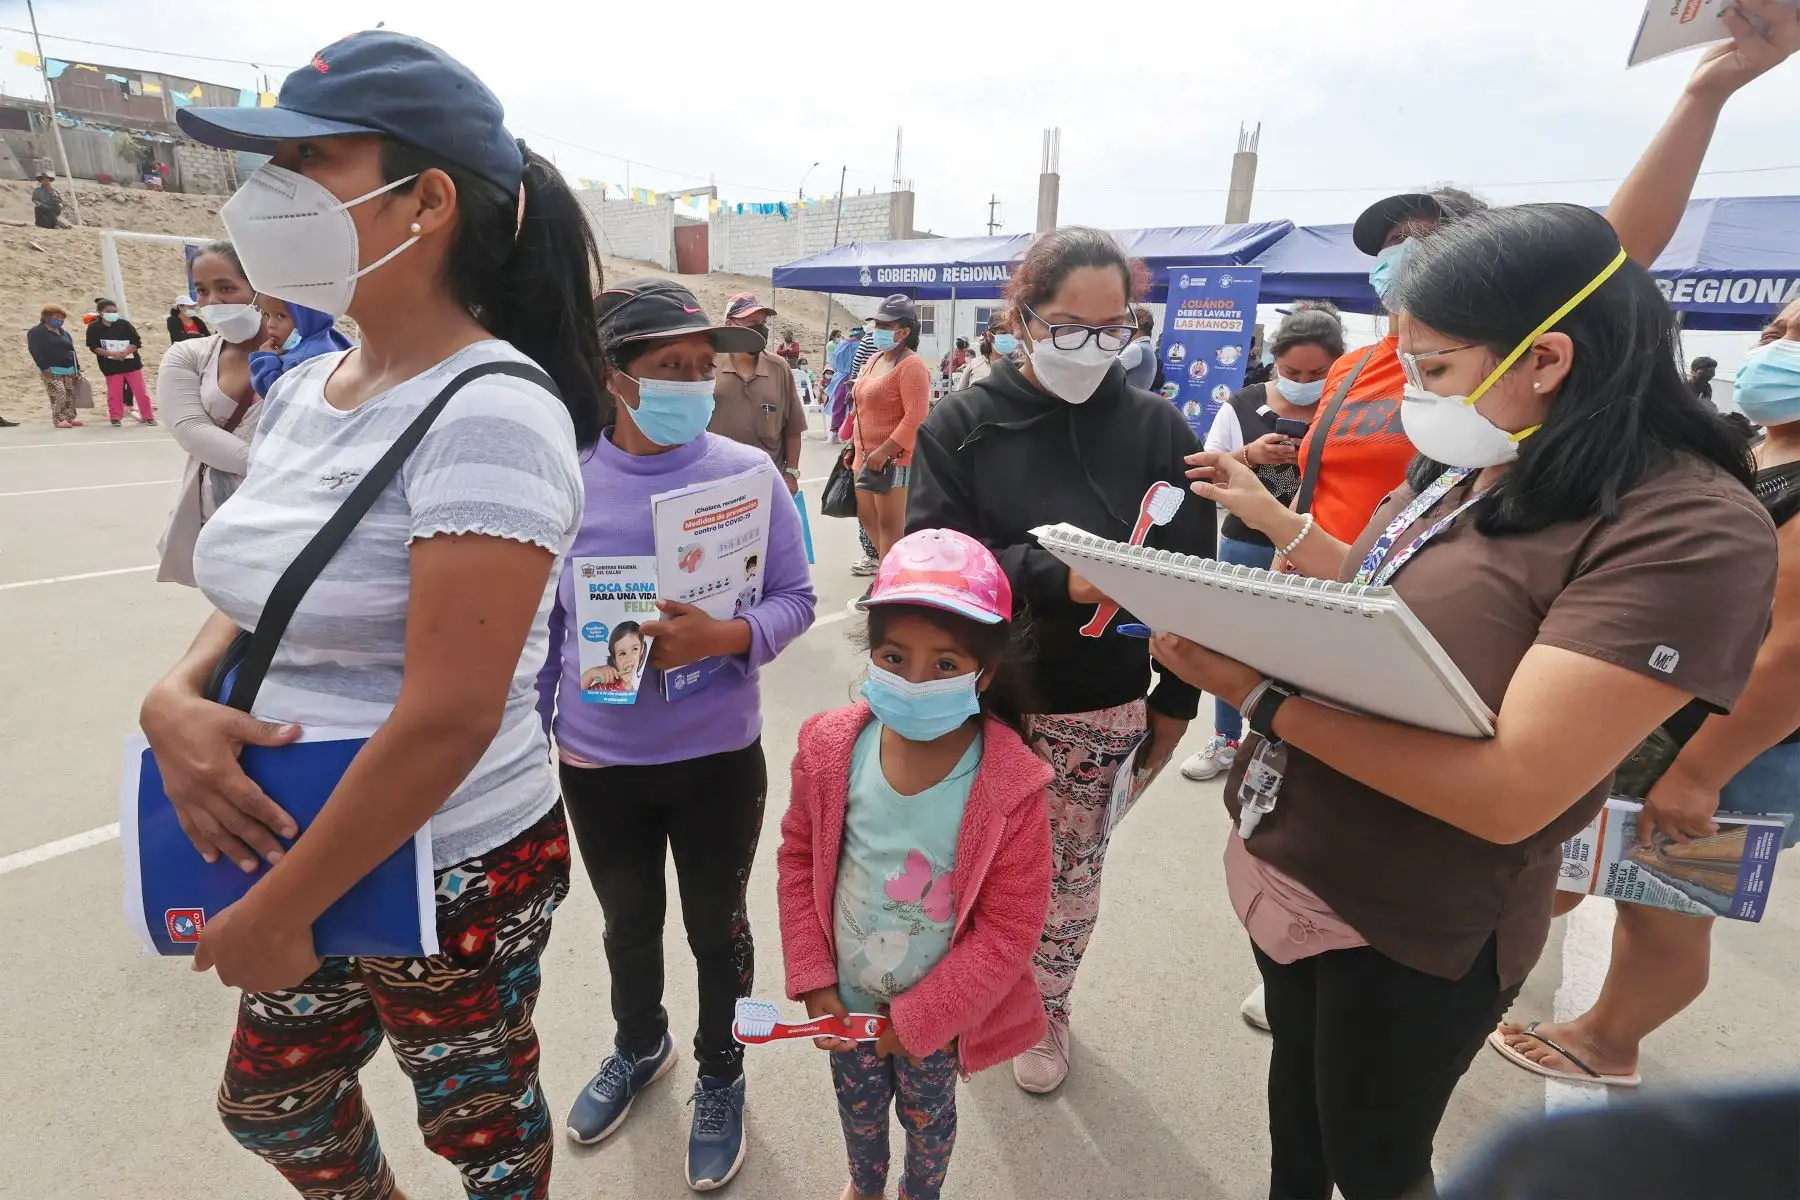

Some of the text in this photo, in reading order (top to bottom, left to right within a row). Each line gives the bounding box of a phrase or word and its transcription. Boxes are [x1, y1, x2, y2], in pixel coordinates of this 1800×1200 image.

[877, 265, 1012, 283] GOBIERNO REGIONAL
[1181, 298, 1235, 309] ¿CUÁNDO
[1177, 309, 1242, 318] DEBES LAVARTE
[1175, 319, 1242, 329] LAS MANOS?
[685, 516, 716, 530] Medidas
[716, 513, 725, 521] de
[694, 525, 717, 536] contra
[724, 513, 751, 528] COVID-19
[588, 582, 656, 593] BOCA SANA
[589, 592, 657, 601] PARA UNA VIDA
[624, 601, 657, 613] FELIZ
[1624, 864, 1639, 899] COSTA VERDE
